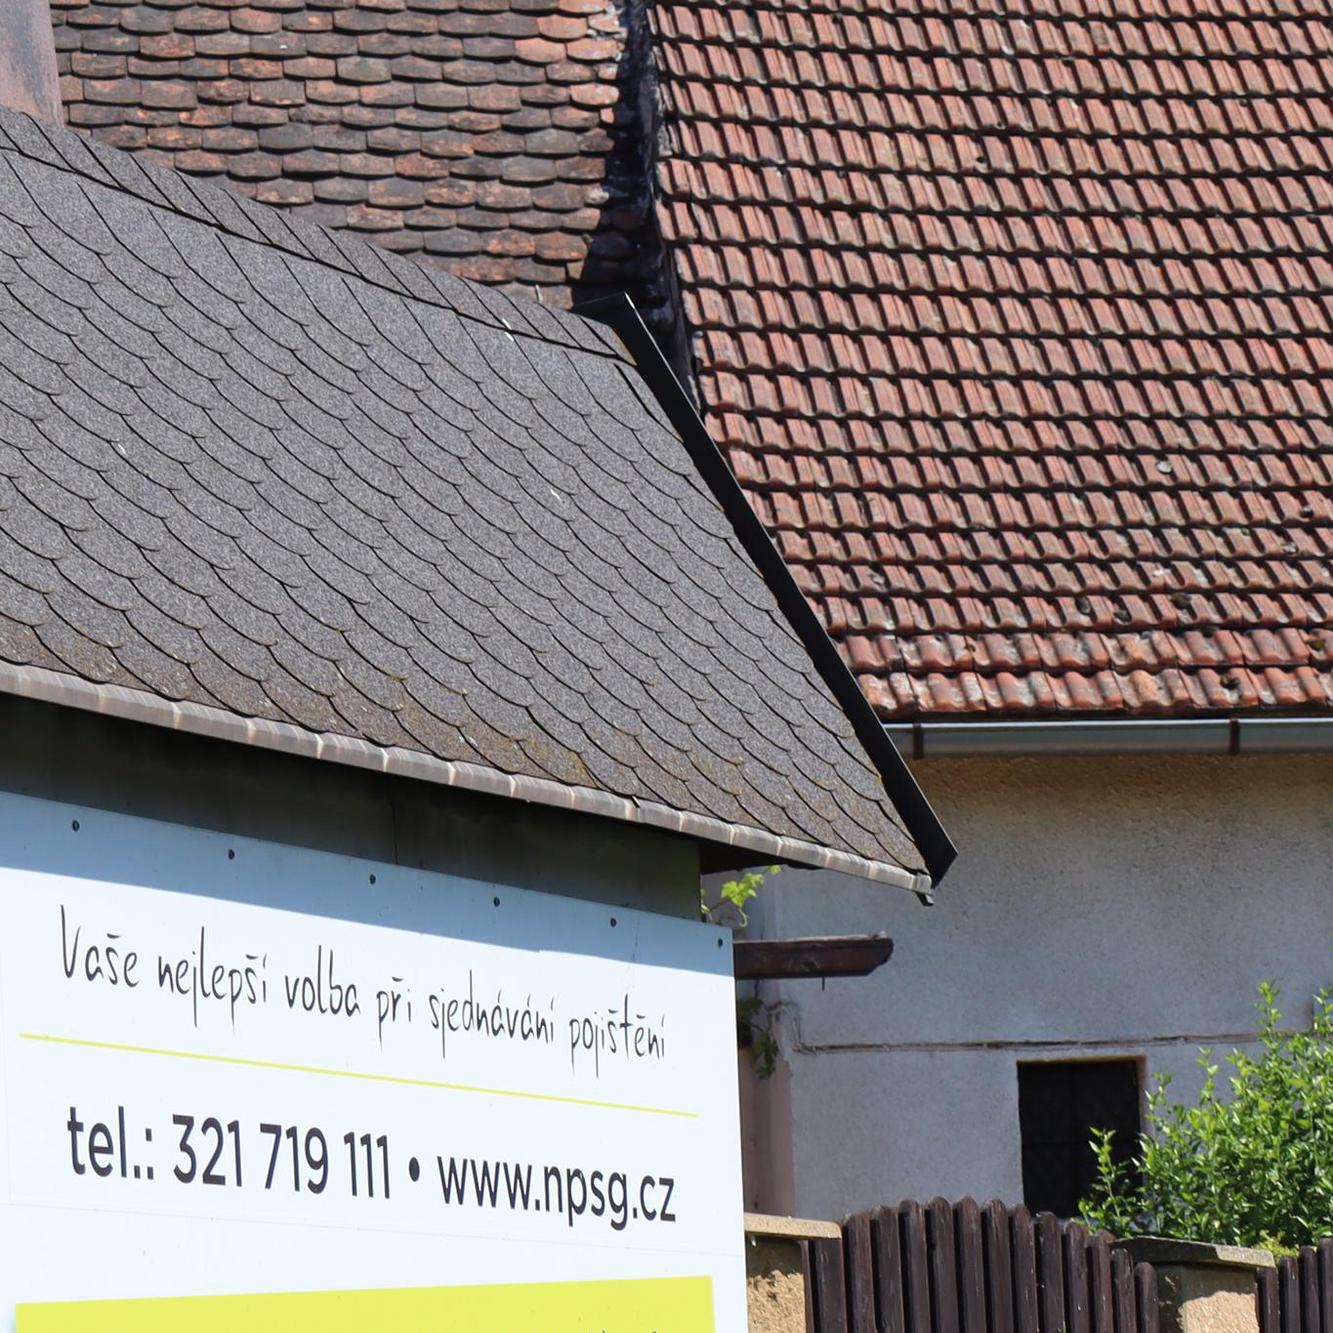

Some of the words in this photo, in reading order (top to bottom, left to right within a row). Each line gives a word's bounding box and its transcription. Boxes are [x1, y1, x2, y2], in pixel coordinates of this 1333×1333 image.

[60, 903, 139, 988] Vaše
[157, 926, 268, 1031] nejlepší
[285, 945, 361, 1017] volba
[377, 977, 412, 1051] při
[429, 970, 556, 1059] sjednávání
[569, 994, 665, 1079] pojištění
[67, 1106, 155, 1181] tel.:
[172, 1112, 243, 1187] 321
[259, 1123, 328, 1194] 719
[344, 1132, 391, 1199] 111
[437, 1152, 677, 1231] www.npsg.cz
